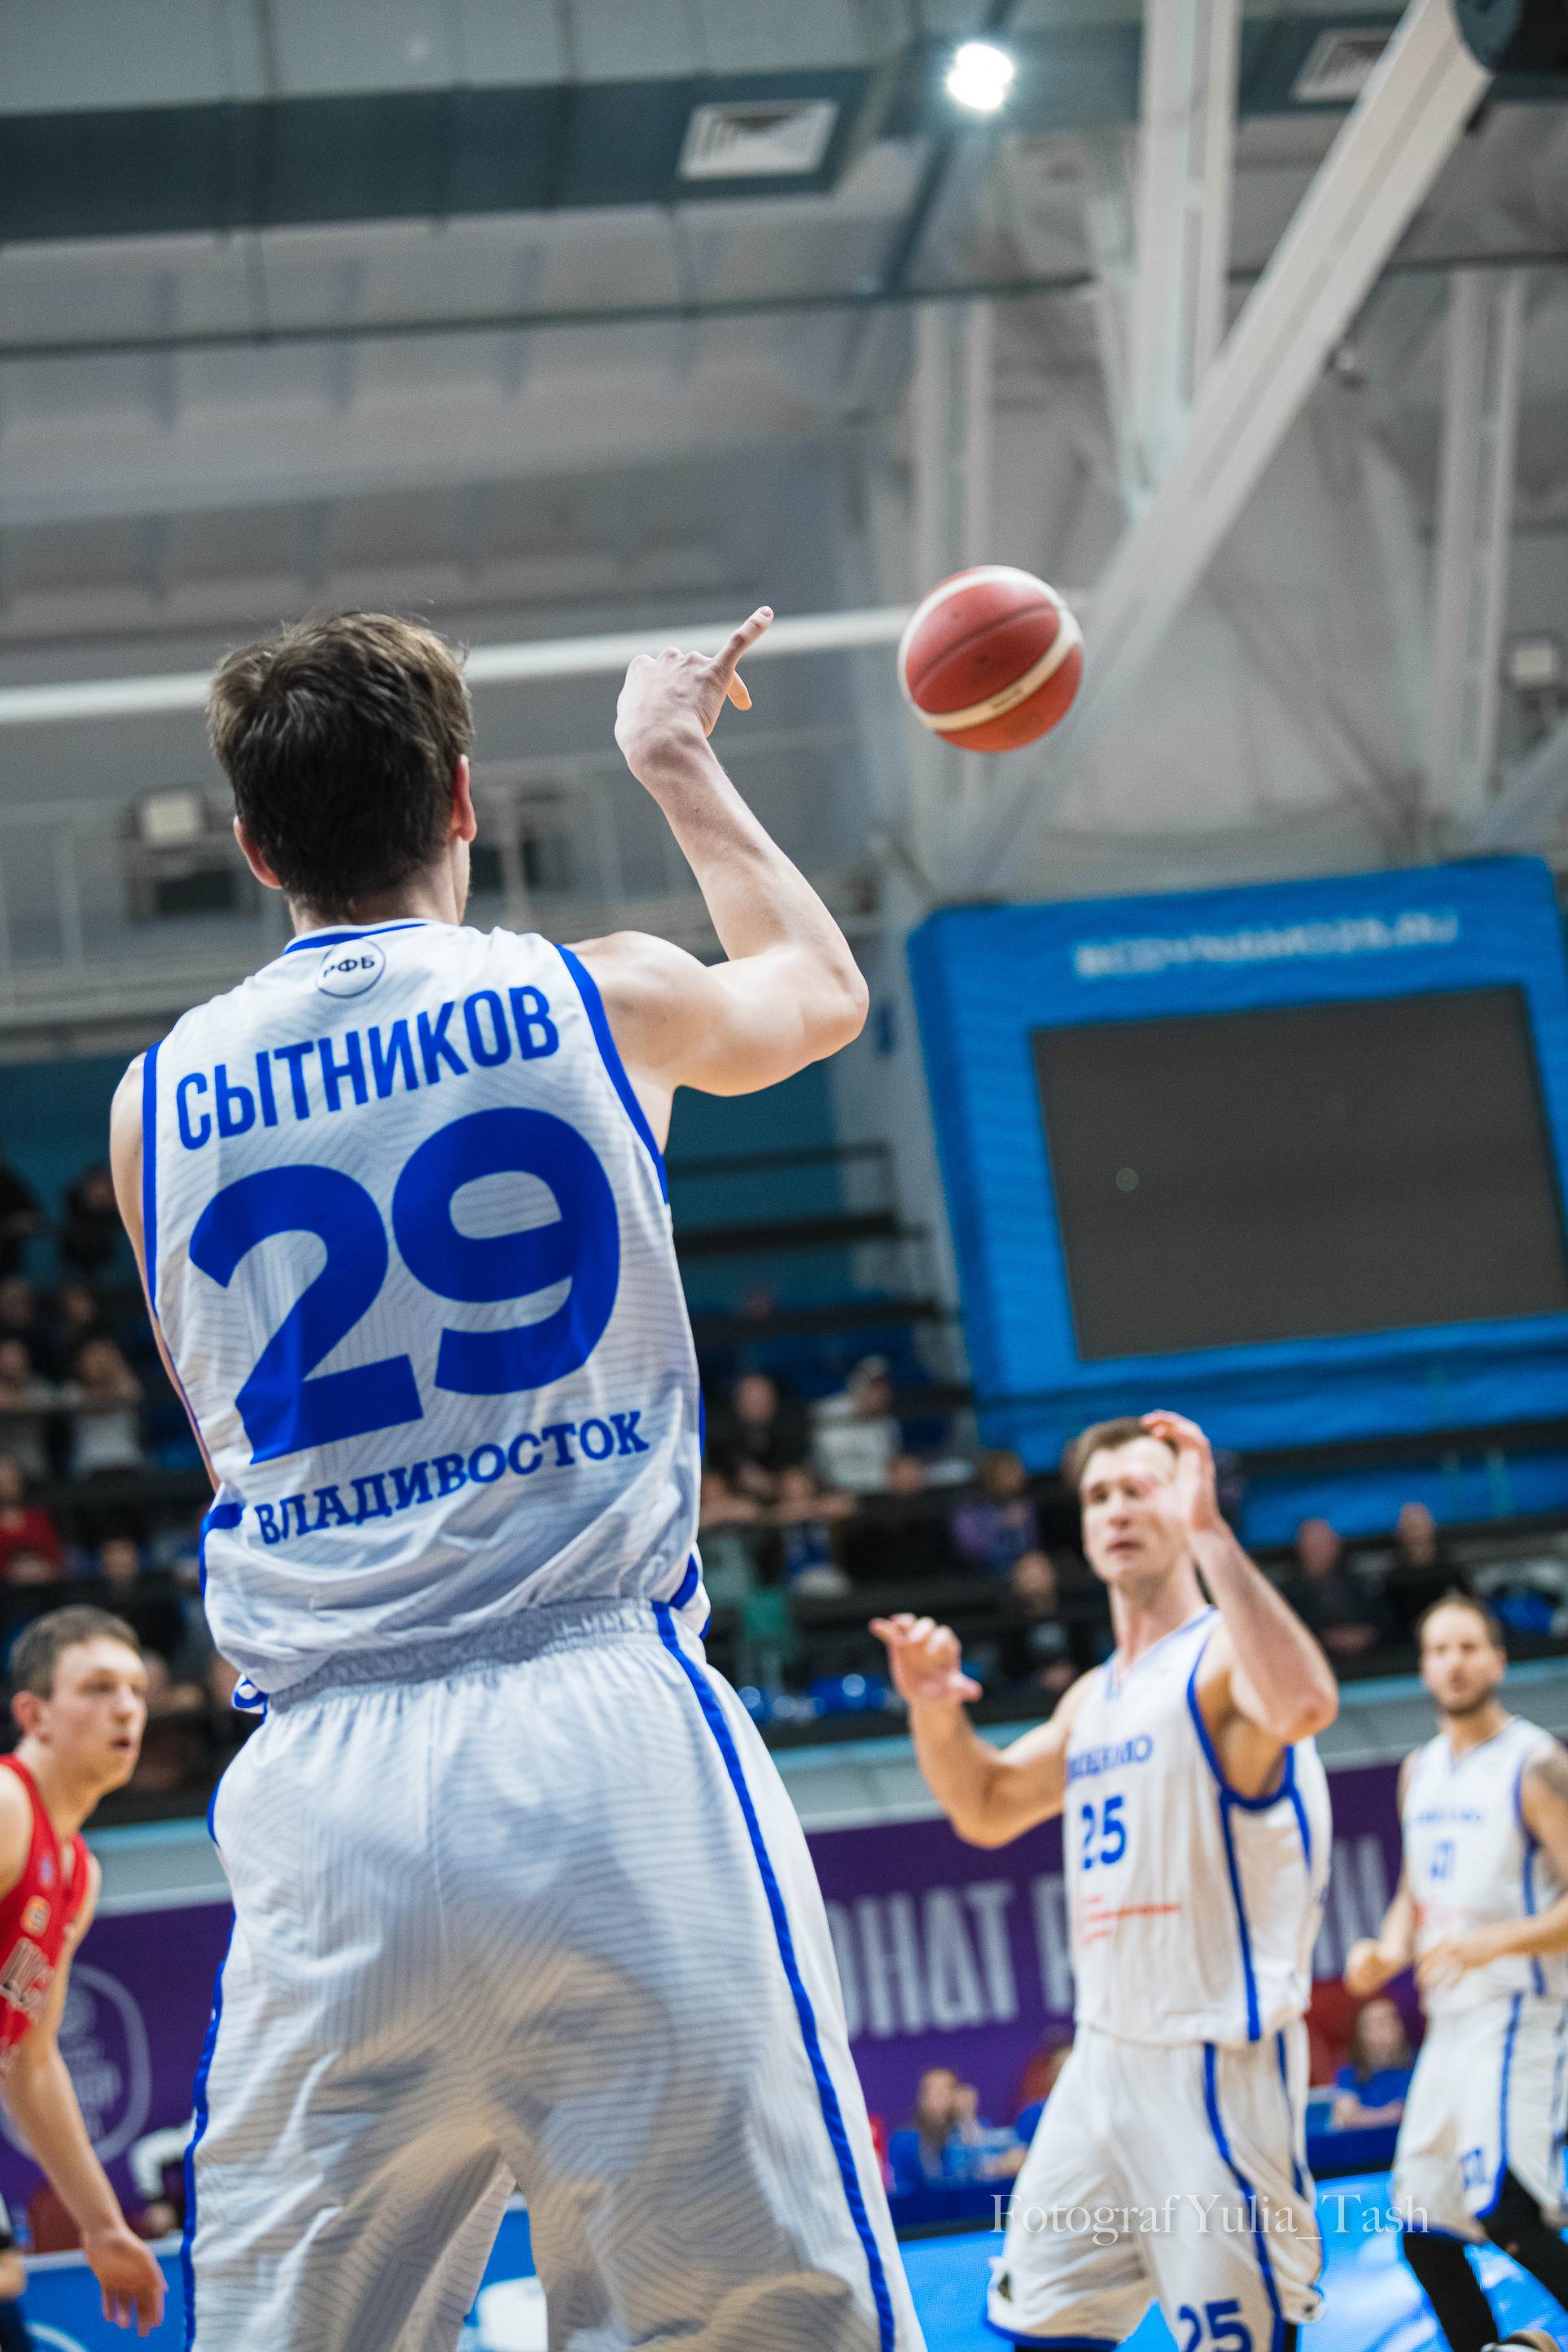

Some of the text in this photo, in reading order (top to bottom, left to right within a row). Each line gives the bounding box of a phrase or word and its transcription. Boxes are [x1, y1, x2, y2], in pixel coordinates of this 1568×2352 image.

[176, 985, 560, 1151] СЫТНИКОВ
[189, 1106, 621, 1465] 29
[253, 1410, 650, 1546] ВЛАДИВОСТОК
[1080, 1794, 1128, 1871] 25
[1178, 2299, 1252, 2352] 25
